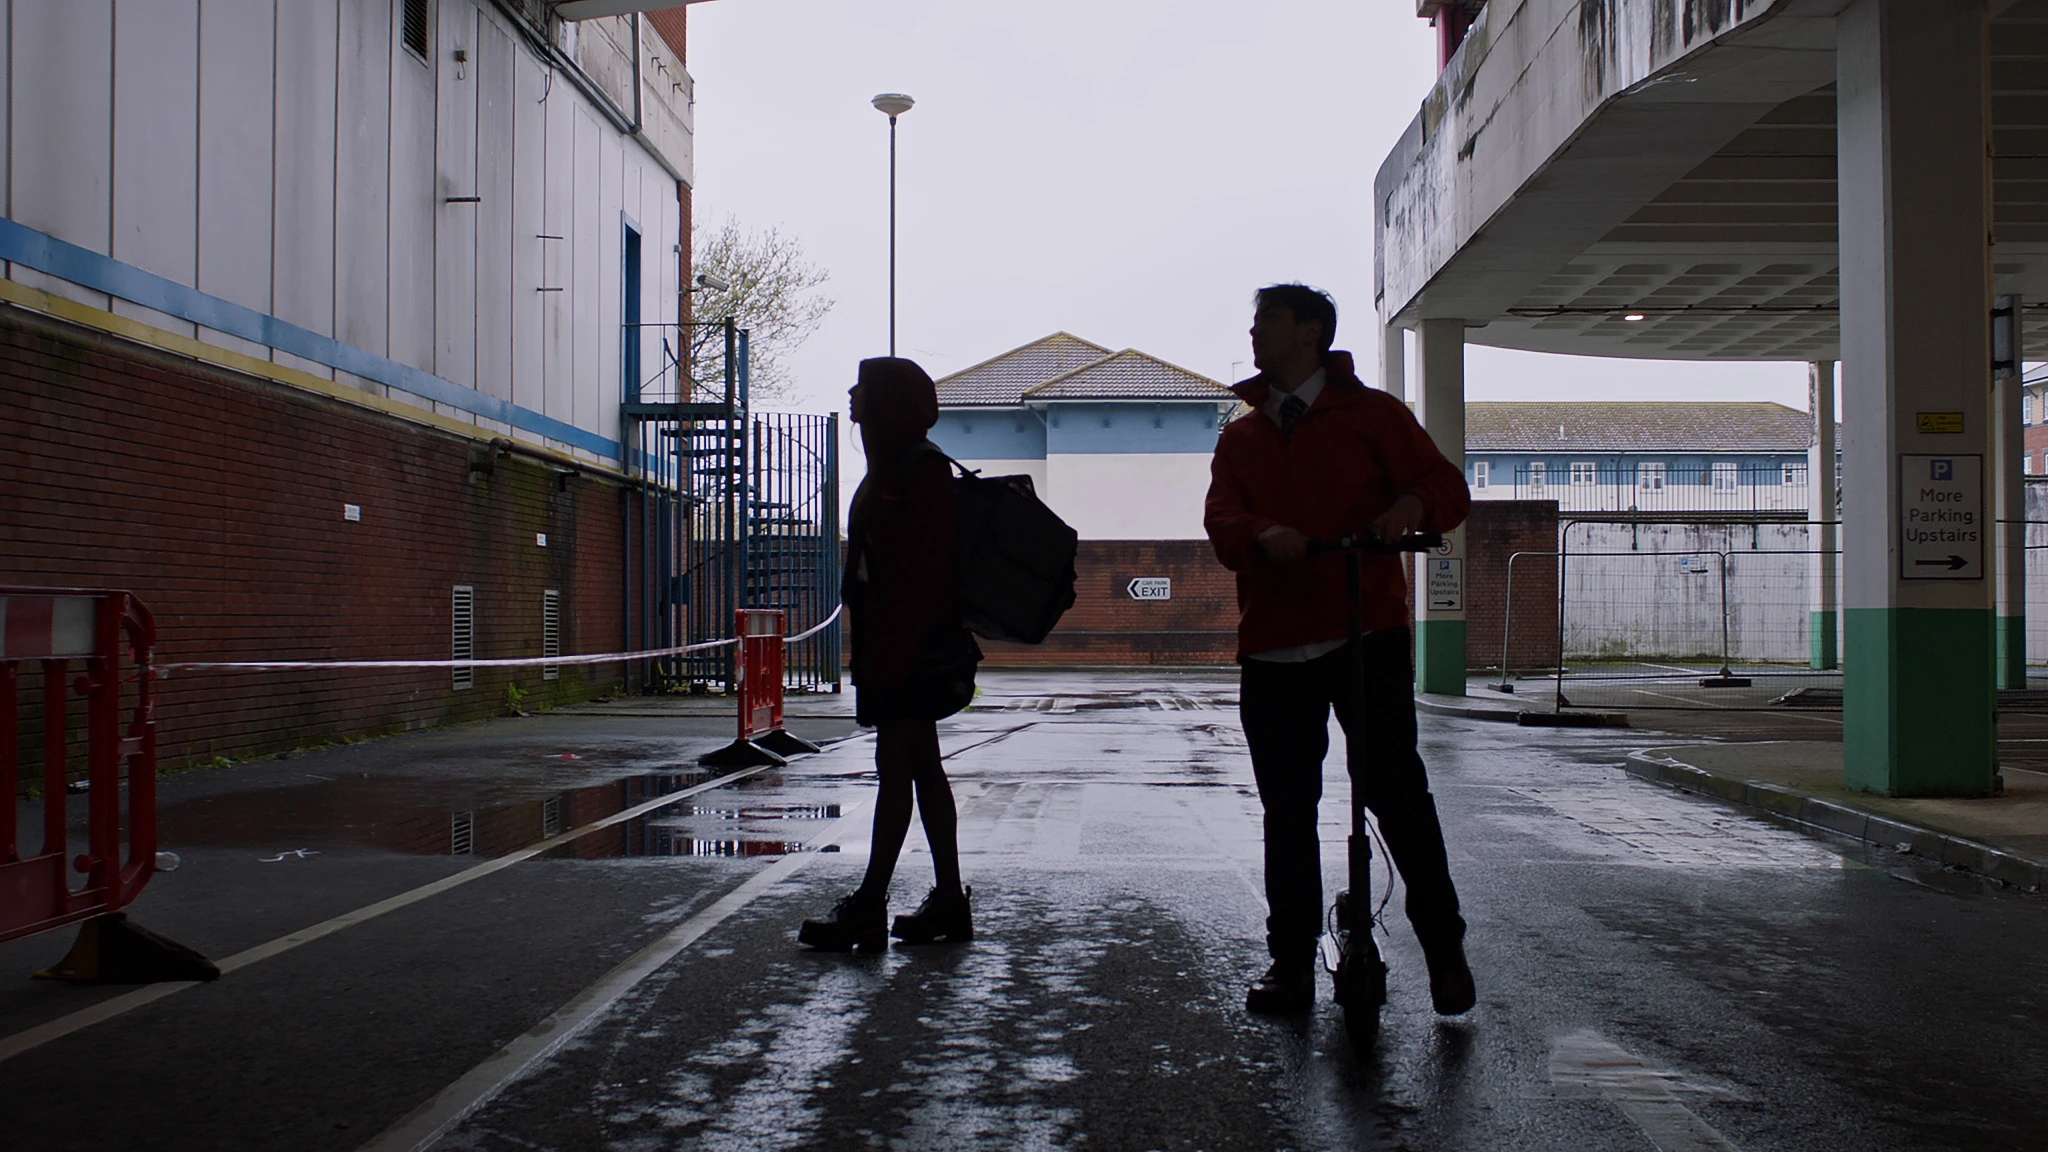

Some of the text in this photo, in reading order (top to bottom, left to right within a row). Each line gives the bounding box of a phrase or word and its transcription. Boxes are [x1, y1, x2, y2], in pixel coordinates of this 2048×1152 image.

[1934, 462, 1948, 479] P
[1920, 489, 1963, 503] More
[1910, 509, 1973, 525] Parking
[1906, 529, 1977, 544] Upstairs
[1440, 542, 1448, 552] 5
[1431, 580, 1458, 588] Parking
[1142, 587, 1168, 596] EXIT
